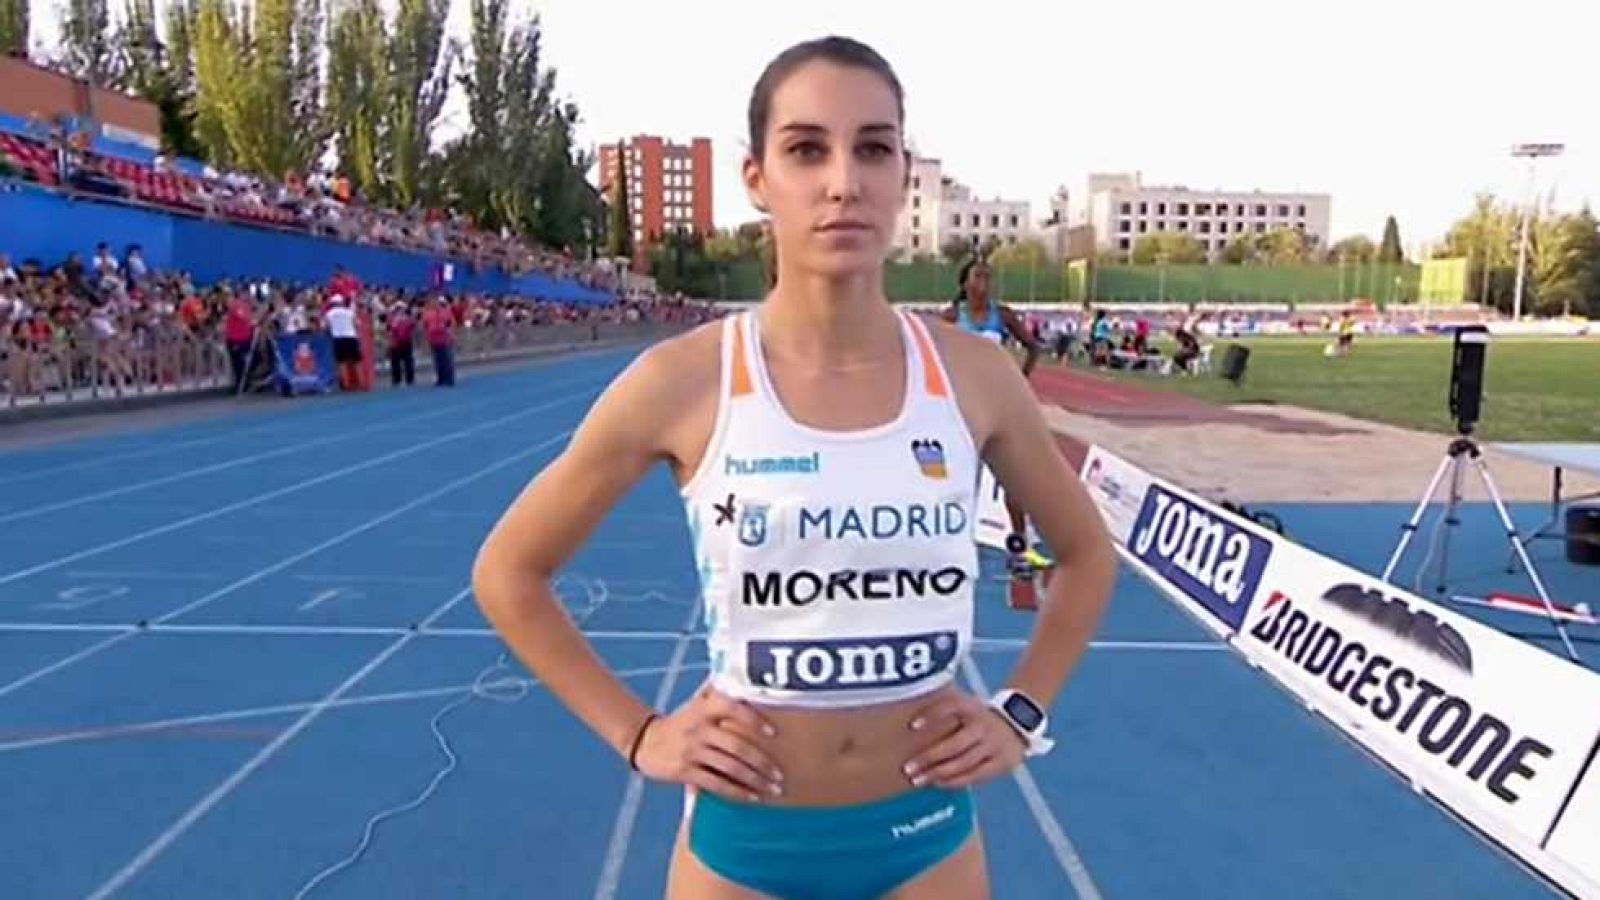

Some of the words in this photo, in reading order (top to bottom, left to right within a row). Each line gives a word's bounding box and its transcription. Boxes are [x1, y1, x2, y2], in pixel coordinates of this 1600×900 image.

[724, 451, 819, 475] hummel
[799, 503, 966, 539] MADRID
[741, 568, 966, 606] MORENO
[1250, 591, 1554, 804] BRIDGESTONE
